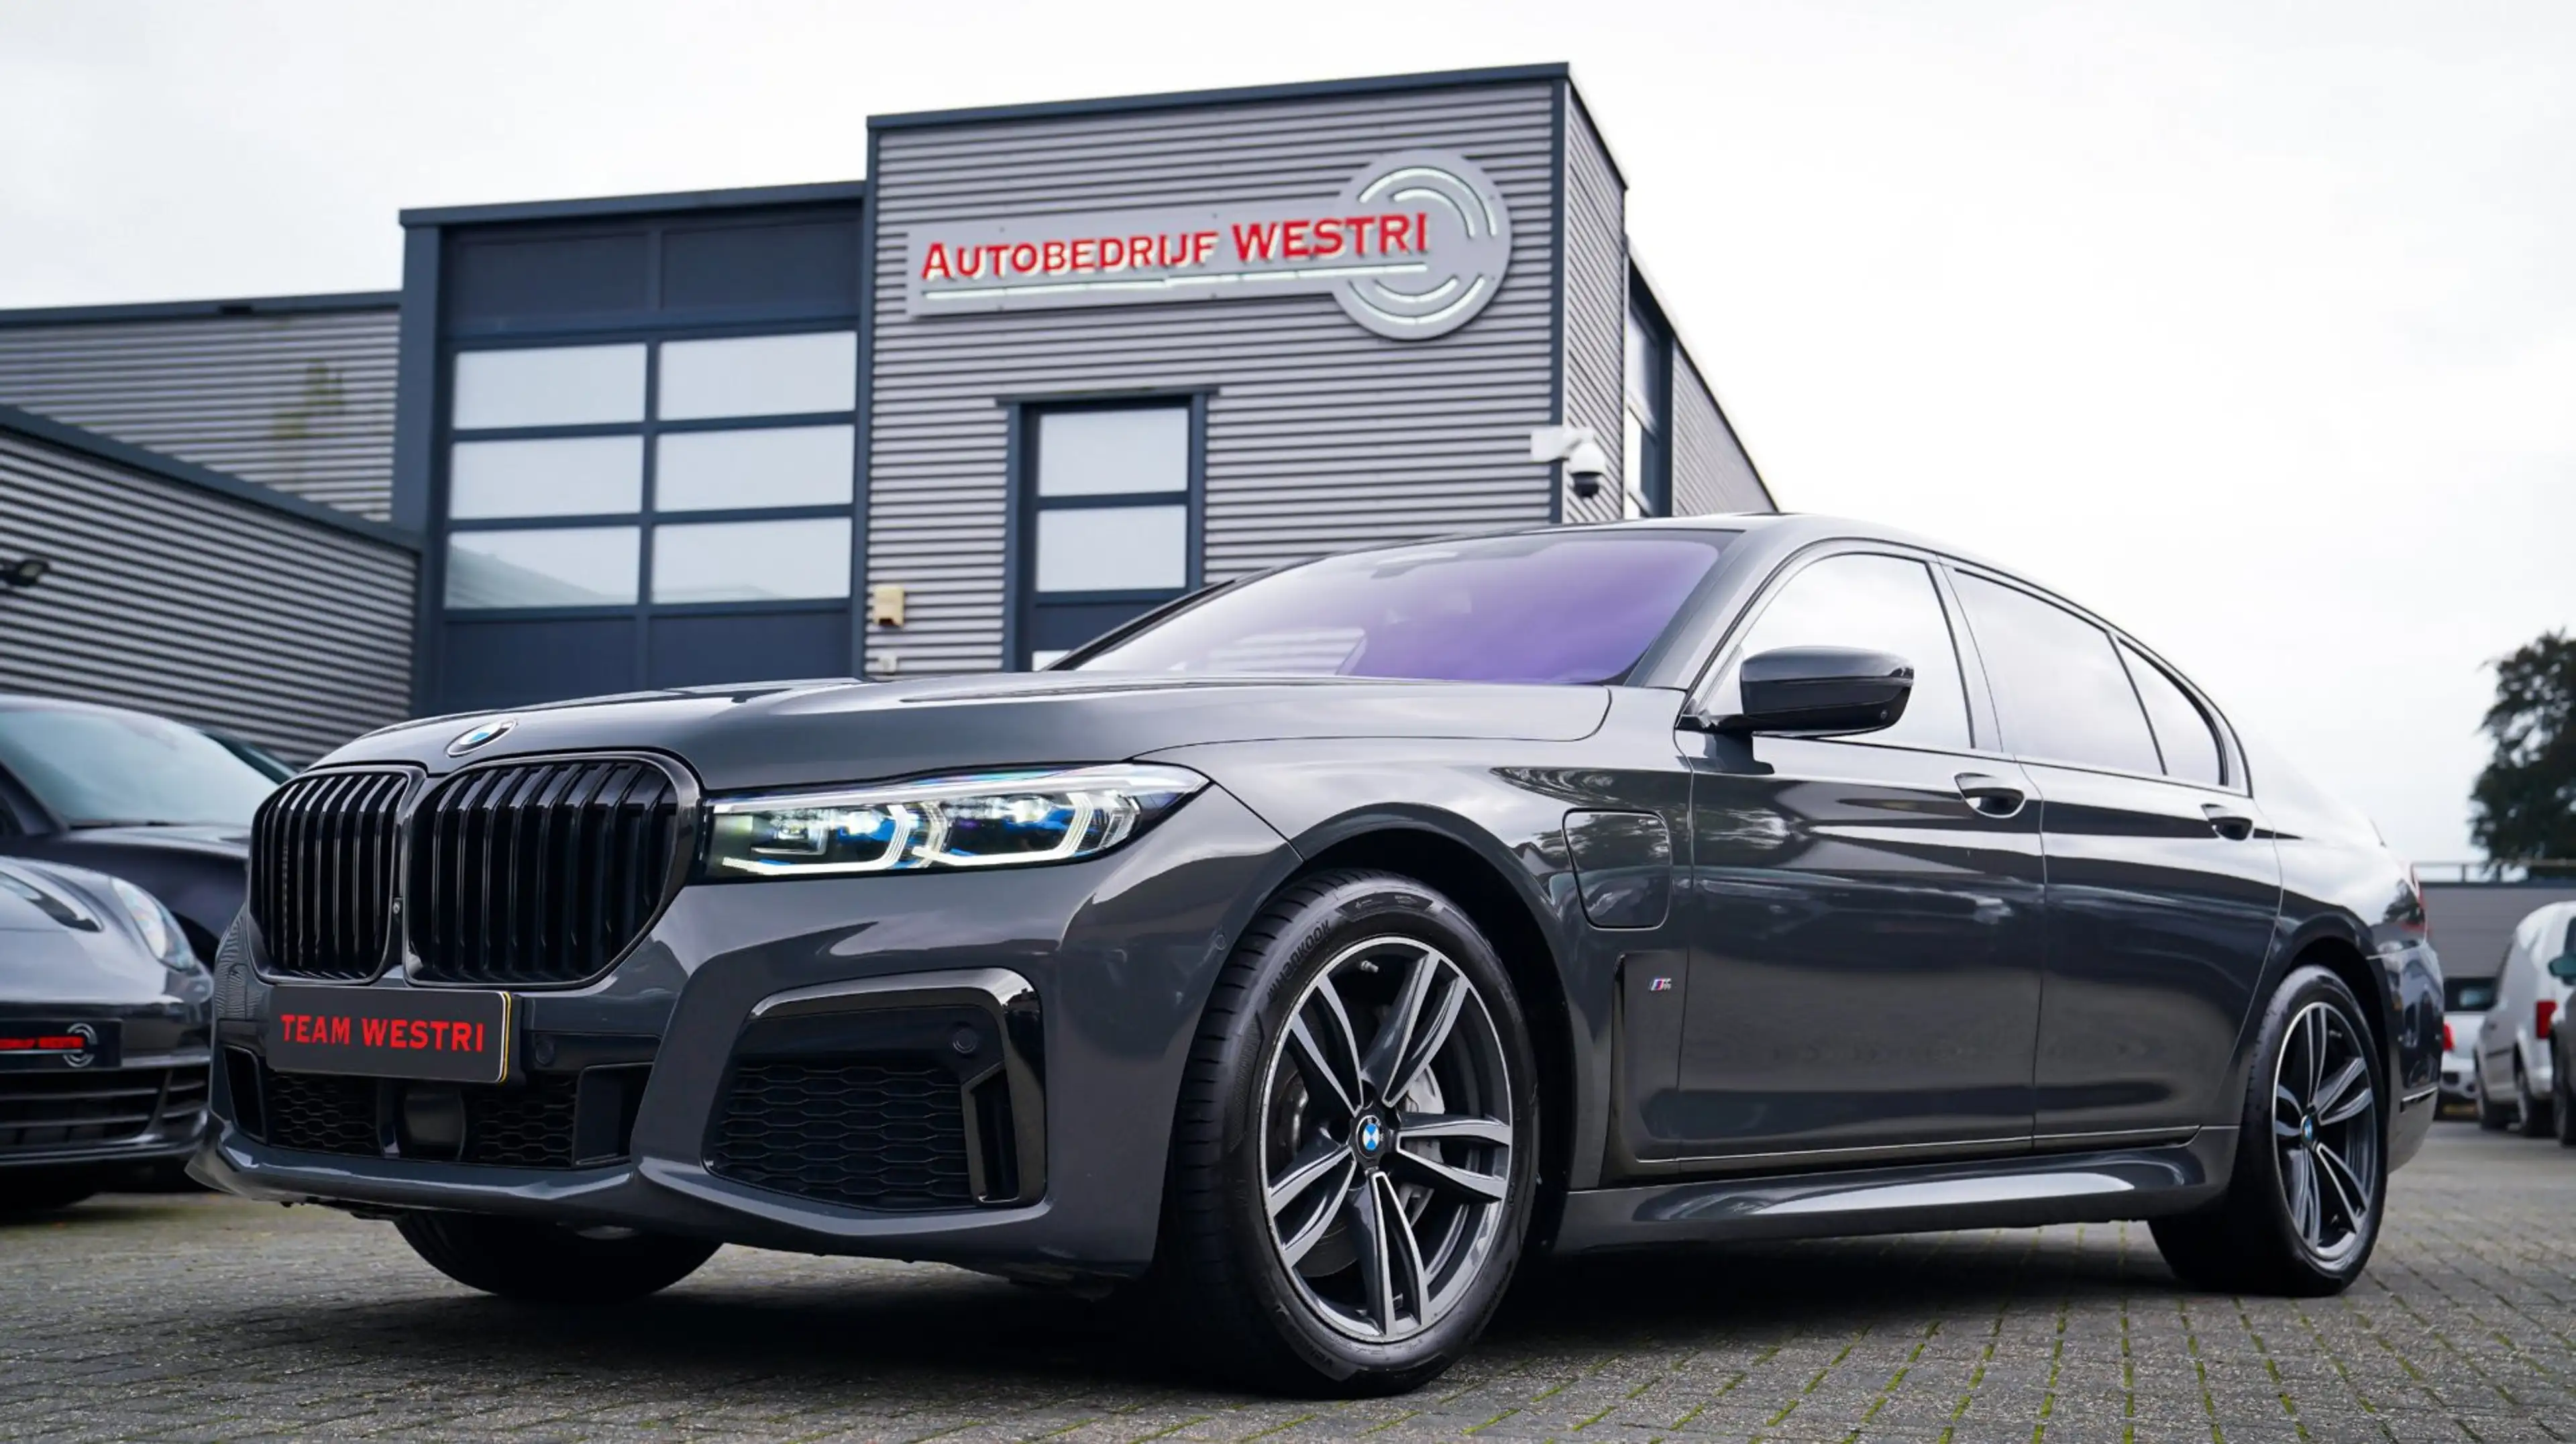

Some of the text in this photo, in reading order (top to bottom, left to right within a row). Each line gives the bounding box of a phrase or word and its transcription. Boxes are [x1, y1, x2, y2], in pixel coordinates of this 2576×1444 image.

[922, 212, 1426, 280] AUTOBEDRIJF WESTRI
[280, 1013, 484, 1052] TEAM WESTRI
